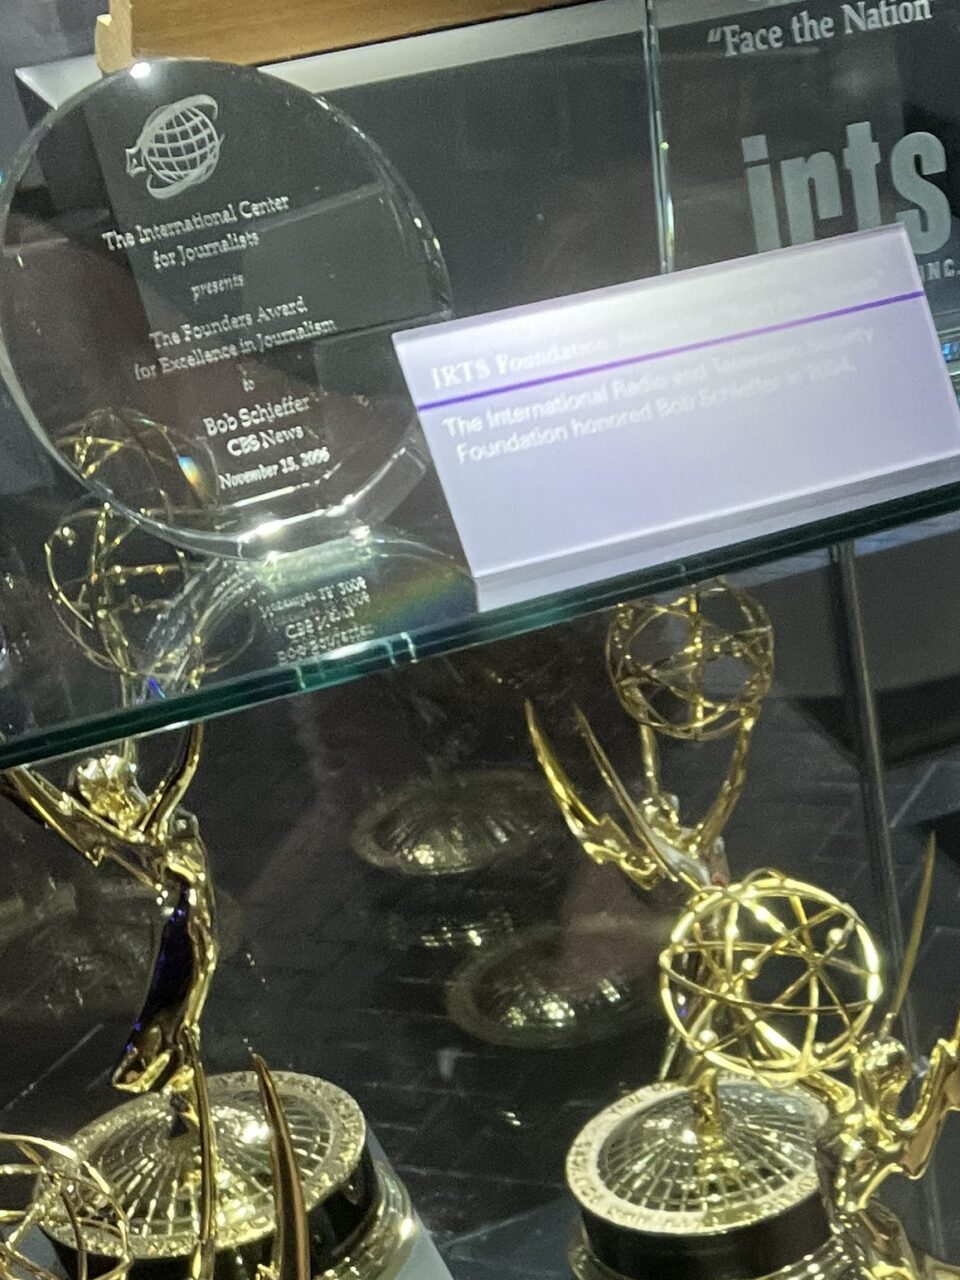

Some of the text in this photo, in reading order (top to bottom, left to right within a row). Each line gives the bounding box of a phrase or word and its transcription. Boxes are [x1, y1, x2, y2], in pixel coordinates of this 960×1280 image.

[791, 10, 835, 44] the
[841, 0, 932, 35] Nation
[741, 121, 951, 255] irts
[102, 196, 289, 250] The International Center
[153, 231, 260, 270] for Journalists
[191, 274, 244, 302] presents
[150, 296, 308, 349] The Founders Award
[134, 319, 337, 381] for Excellence in Journalism
[242, 379, 255, 392] to
[431, 357, 491, 389] IRTS
[203, 395, 310, 436] Bob Schieffer
[442, 416, 484, 438] The
[485, 383, 609, 428] International
[227, 426, 304, 457] CBS News
[456, 424, 569, 465] Foundation
[571, 401, 654, 438] honored
[218, 464, 278, 490] November
